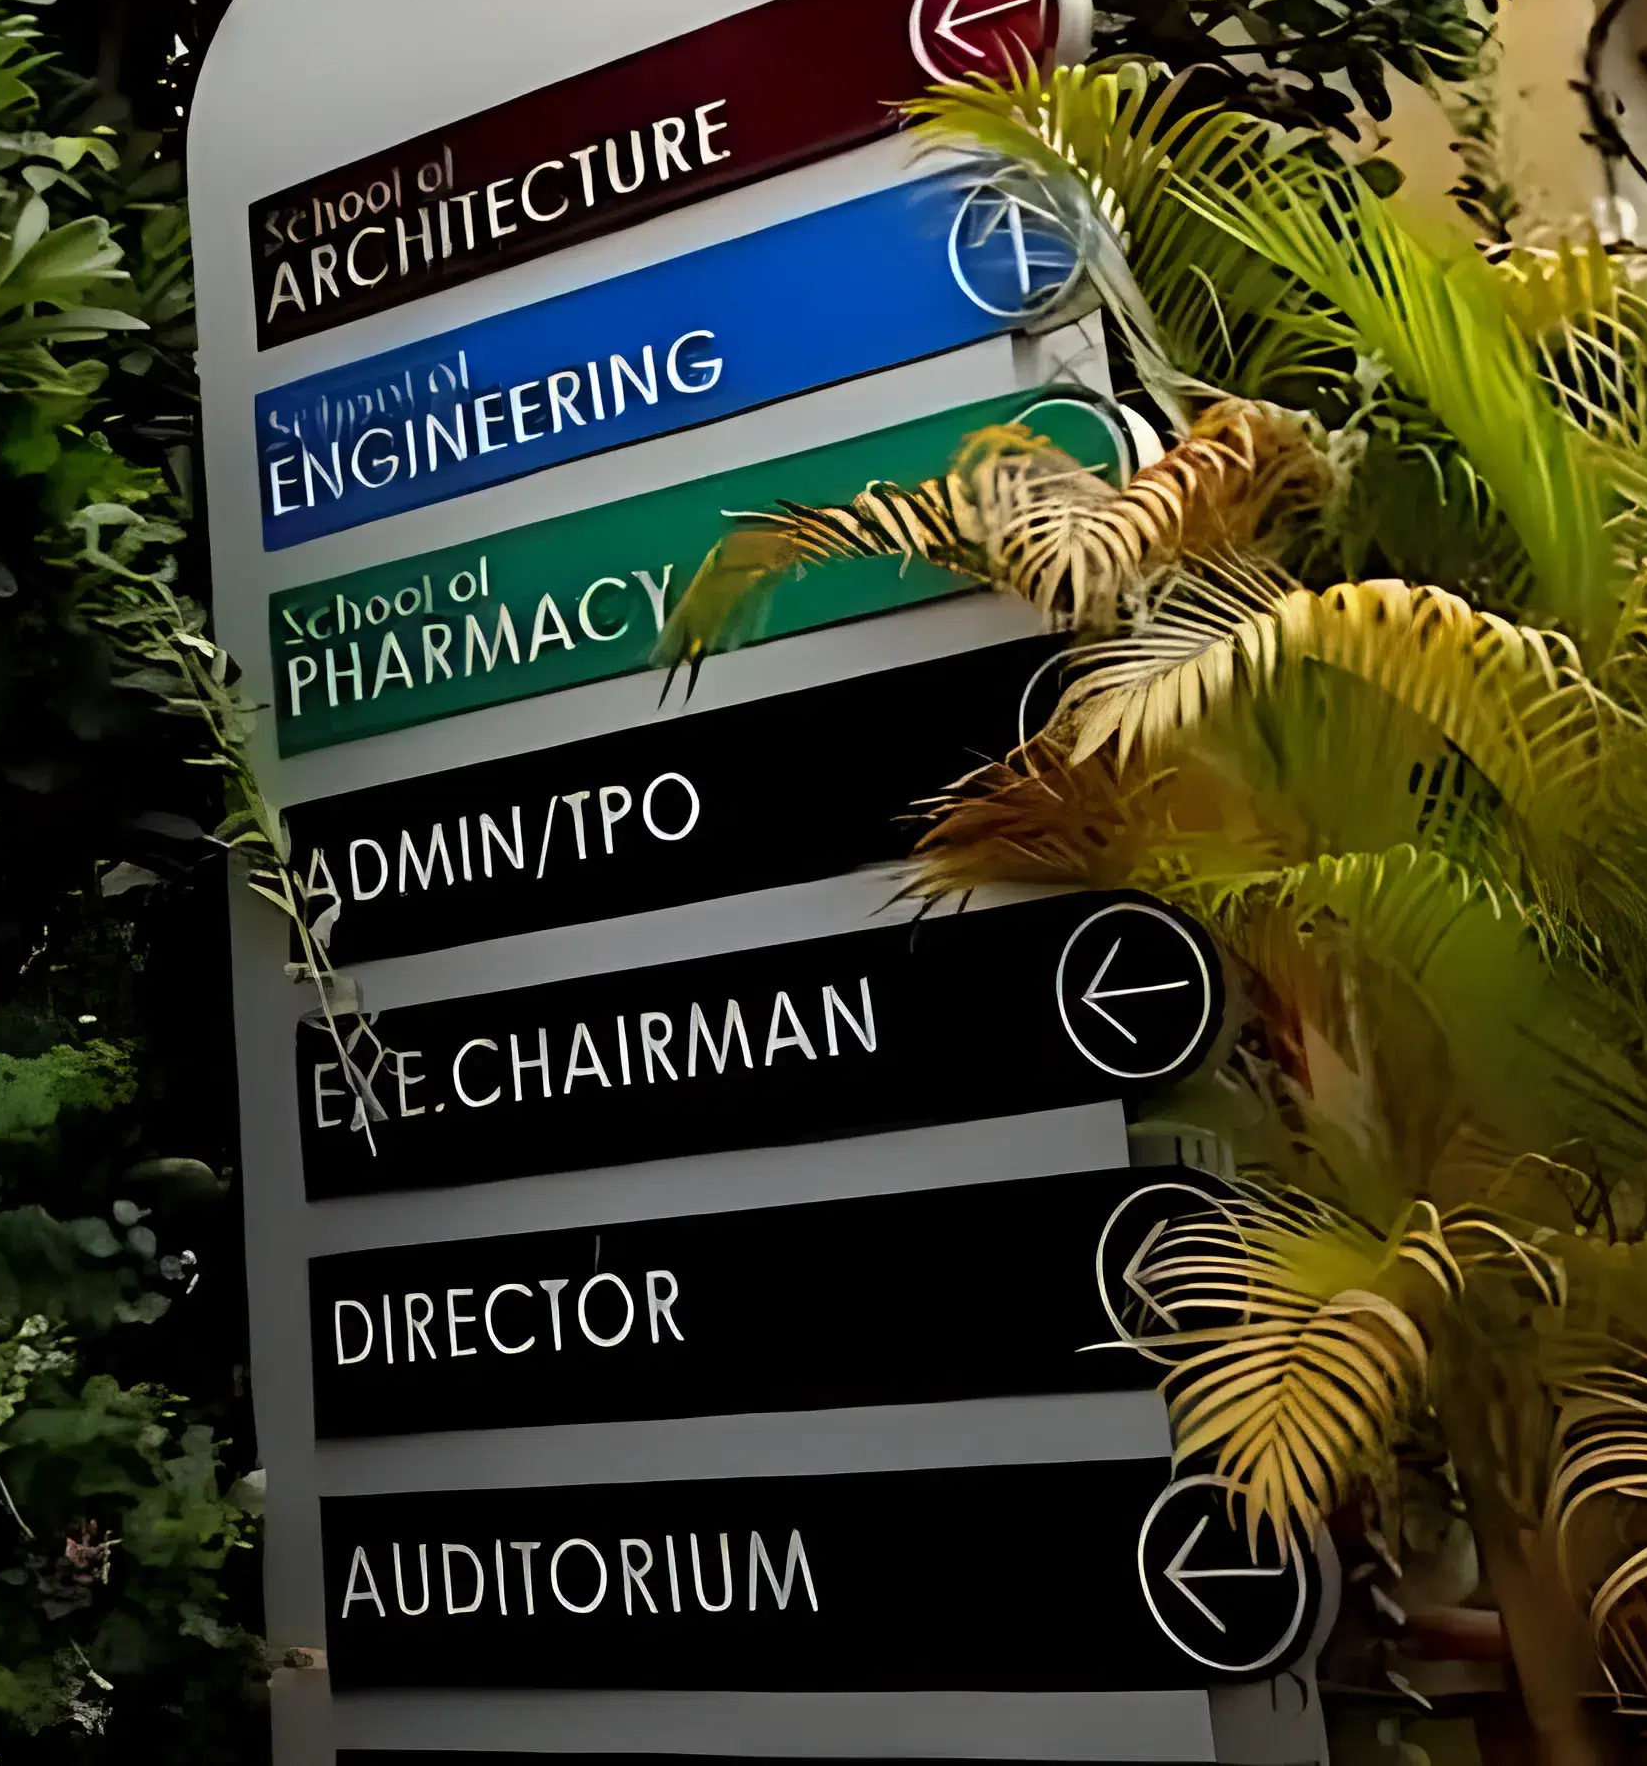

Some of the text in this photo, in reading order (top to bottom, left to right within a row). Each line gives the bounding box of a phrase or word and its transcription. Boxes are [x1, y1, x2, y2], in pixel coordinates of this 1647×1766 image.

[266, 98, 732, 324] ARCHITECTURE
[269, 329, 724, 517] ENGINEERING
[281, 574, 435, 645] School
[287, 563, 675, 717] PHARMACY
[306, 771, 701, 903] ADMIN/TPO
[333, 1268, 686, 1366] DIRECTOR
[341, 1527, 820, 1619] AUDITORIUM
